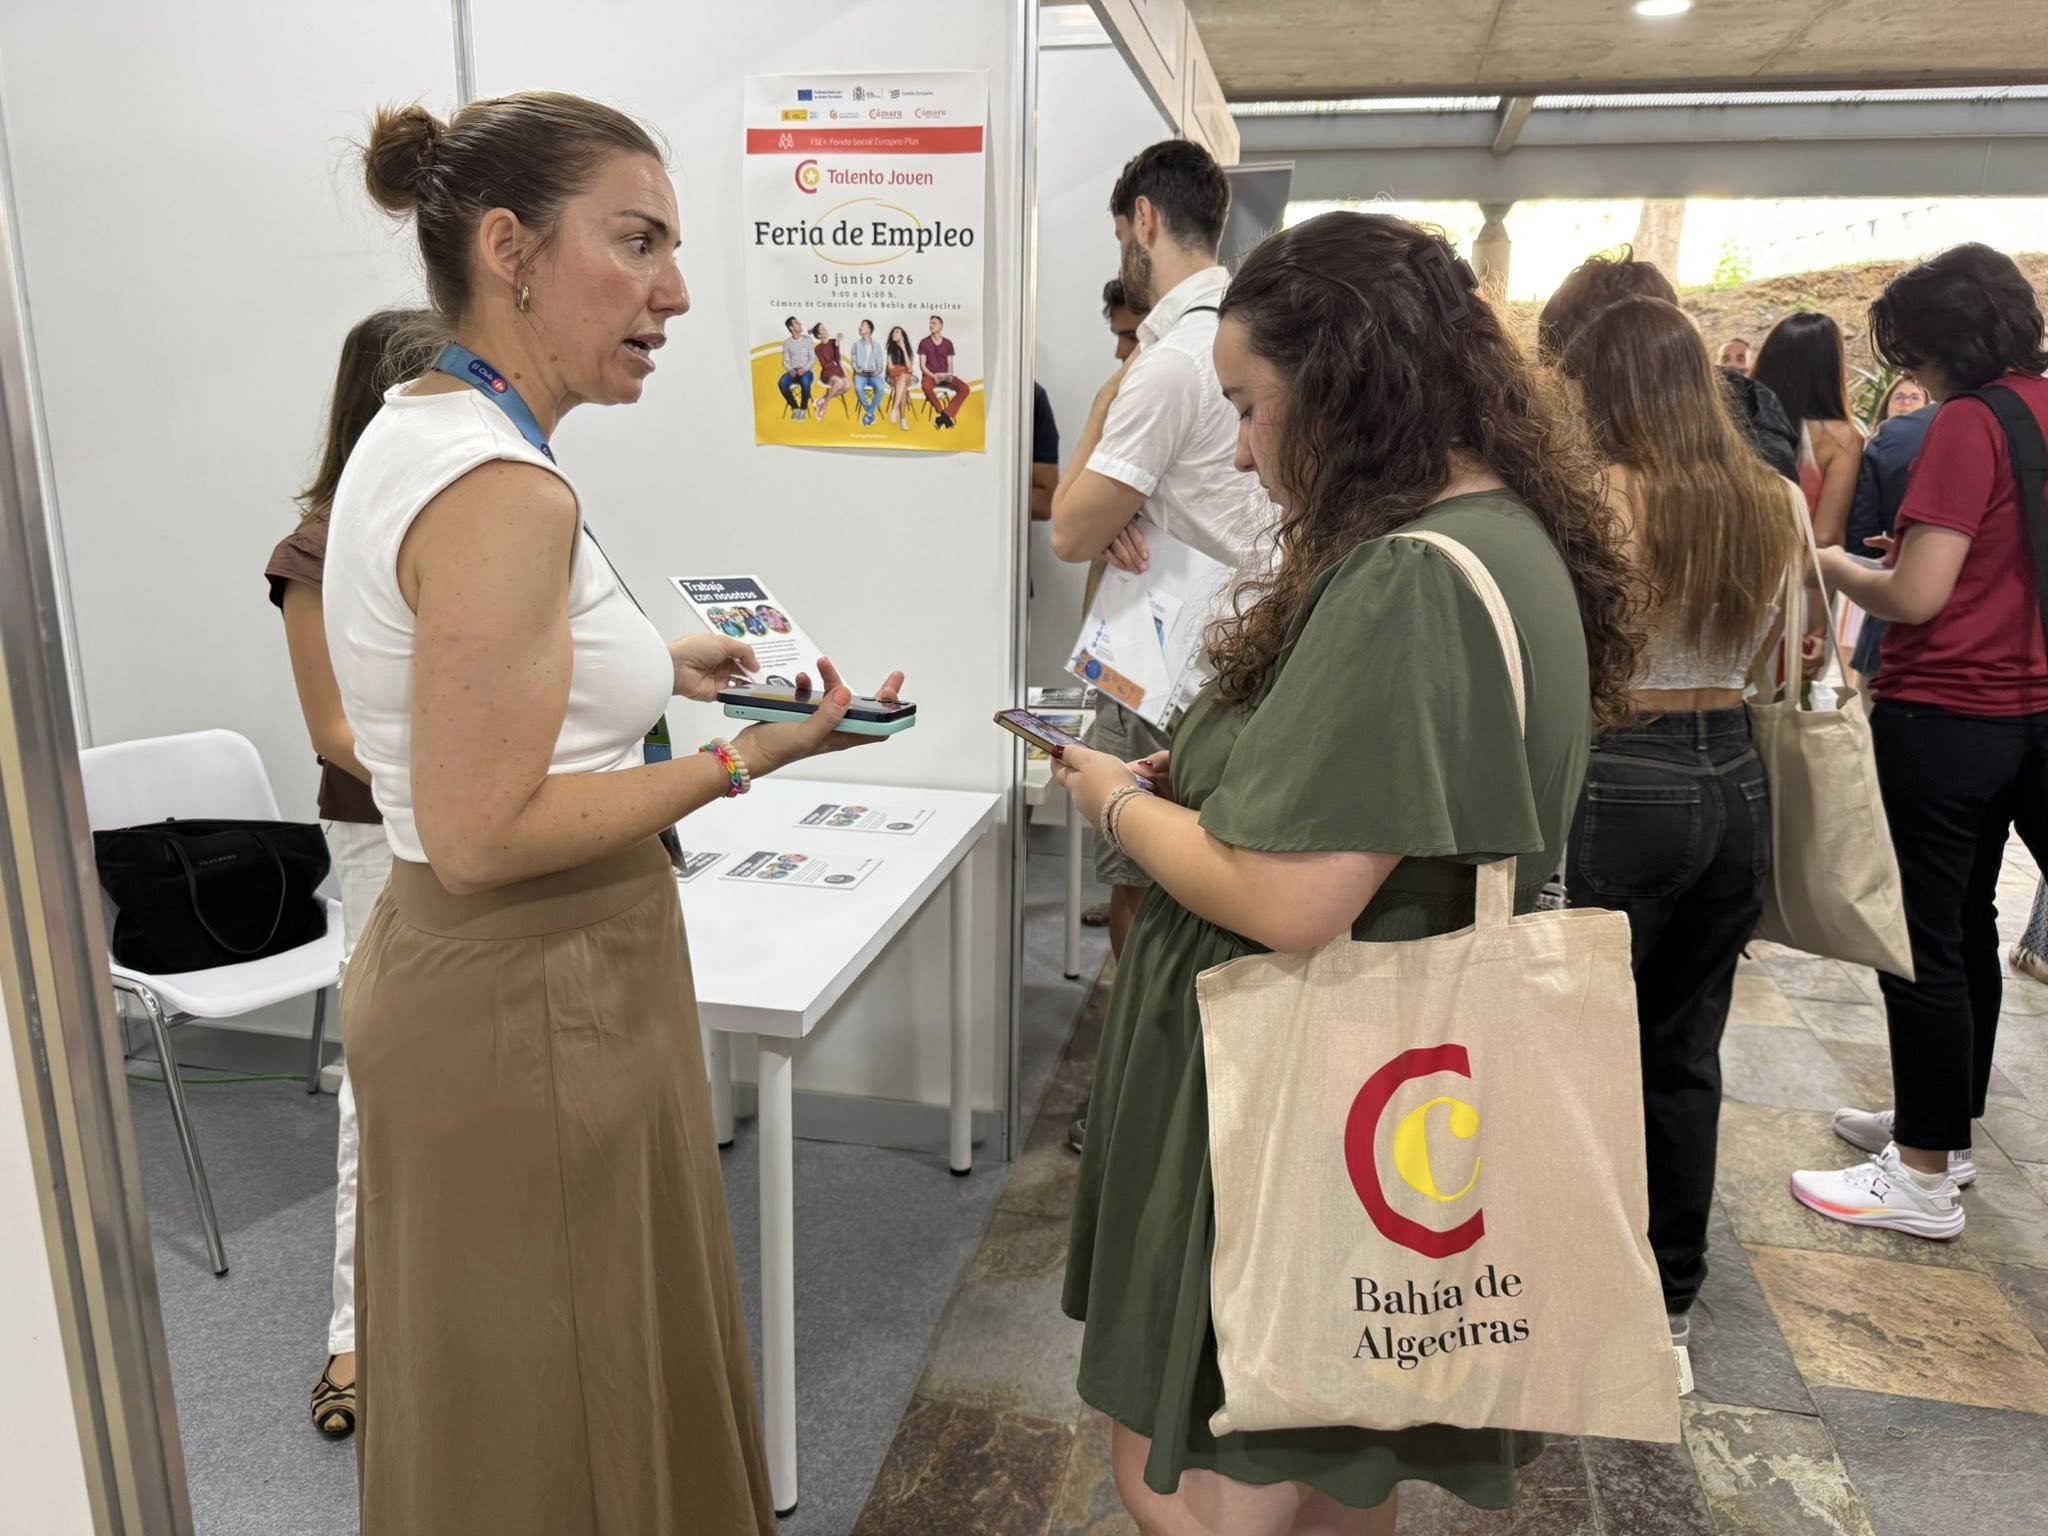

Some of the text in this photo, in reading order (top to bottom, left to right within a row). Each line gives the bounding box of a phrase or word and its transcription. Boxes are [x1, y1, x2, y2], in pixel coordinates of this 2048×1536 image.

[829, 137, 851, 146] Fondo
[853, 136, 873, 146] Social
[874, 137, 903, 148] Europeo
[904, 136, 920, 146] Plus
[827, 169, 933, 186] Talento Joven
[754, 220, 974, 253] Feria de Empleo
[814, 273, 914, 287] 10 junio 2026
[831, 290, 851, 298] 9:00
[805, 300, 815, 308] de
[816, 300, 855, 309] Comercio
[857, 301, 868, 309] de
[869, 301, 879, 309] la
[908, 302, 918, 310] de
[920, 302, 962, 311] Algeciras
[479, 368, 493, 380] Club
[682, 581, 725, 593] Trabaja
[694, 591, 758, 601] con nosotros
[1352, 1264, 1524, 1316] Bahía de
[1352, 1316, 1530, 1371] Algeciras
